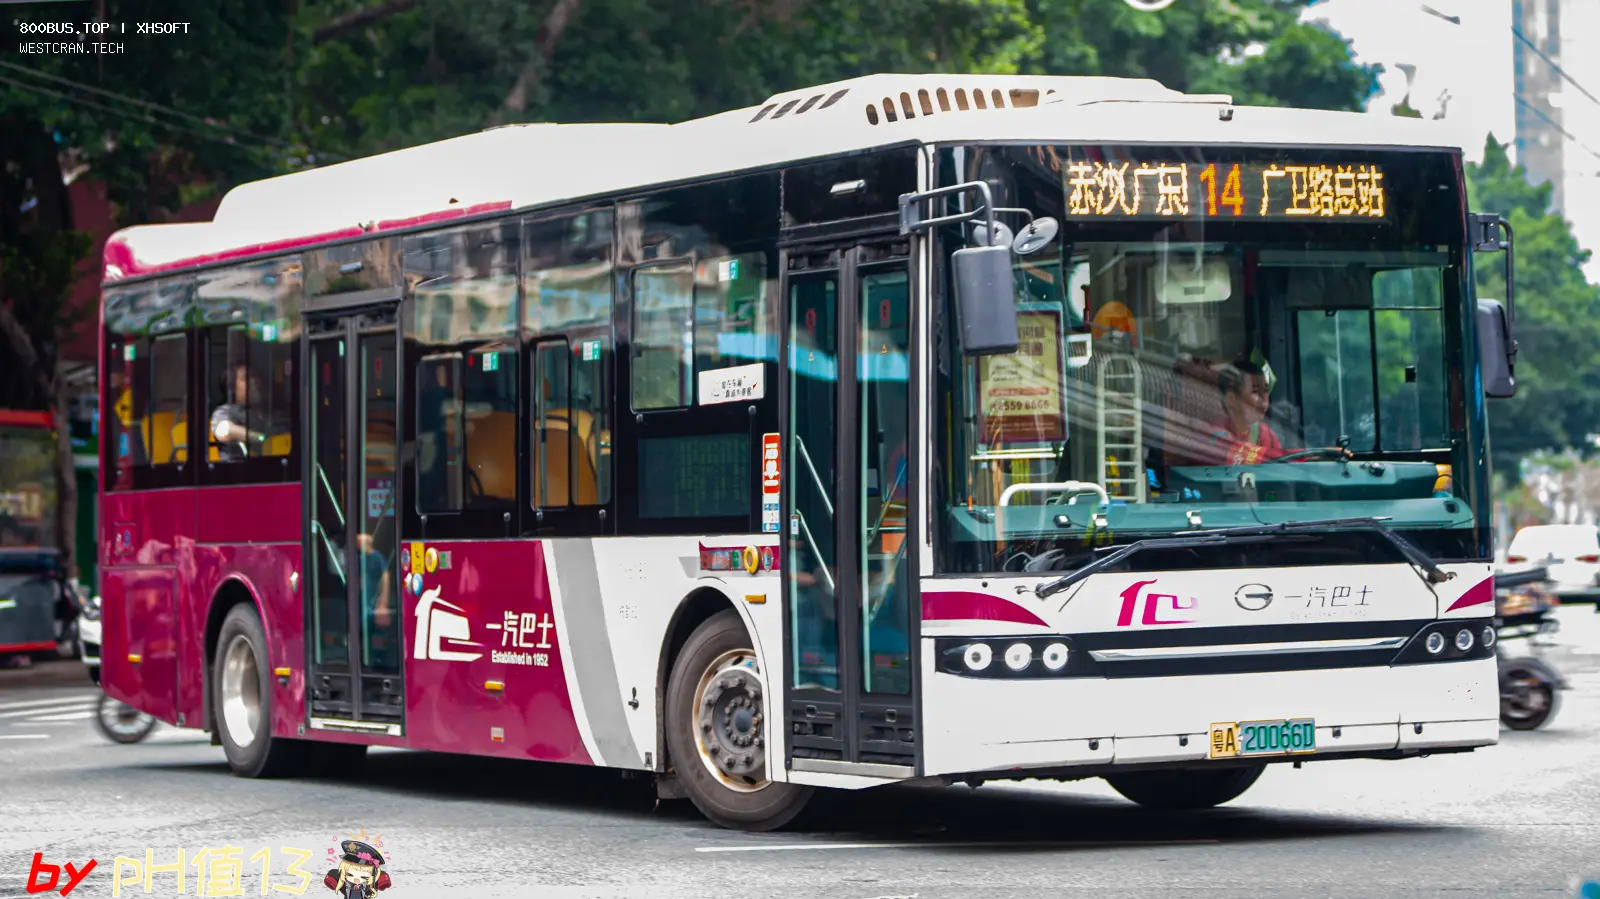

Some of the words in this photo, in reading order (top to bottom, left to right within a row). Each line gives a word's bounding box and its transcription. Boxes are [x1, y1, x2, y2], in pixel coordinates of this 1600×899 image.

[1068, 161, 1189, 215] 赤沙(广东
[1199, 163, 1245, 216] 14
[1259, 164, 1385, 217] 广卫路总站
[1284, 584, 1373, 608] 一汽巴士
[485, 610, 554, 649] 一汽巴士
[491, 649, 525, 665] Established
[526, 652, 532, 666] in
[533, 653, 549, 667] 1952
